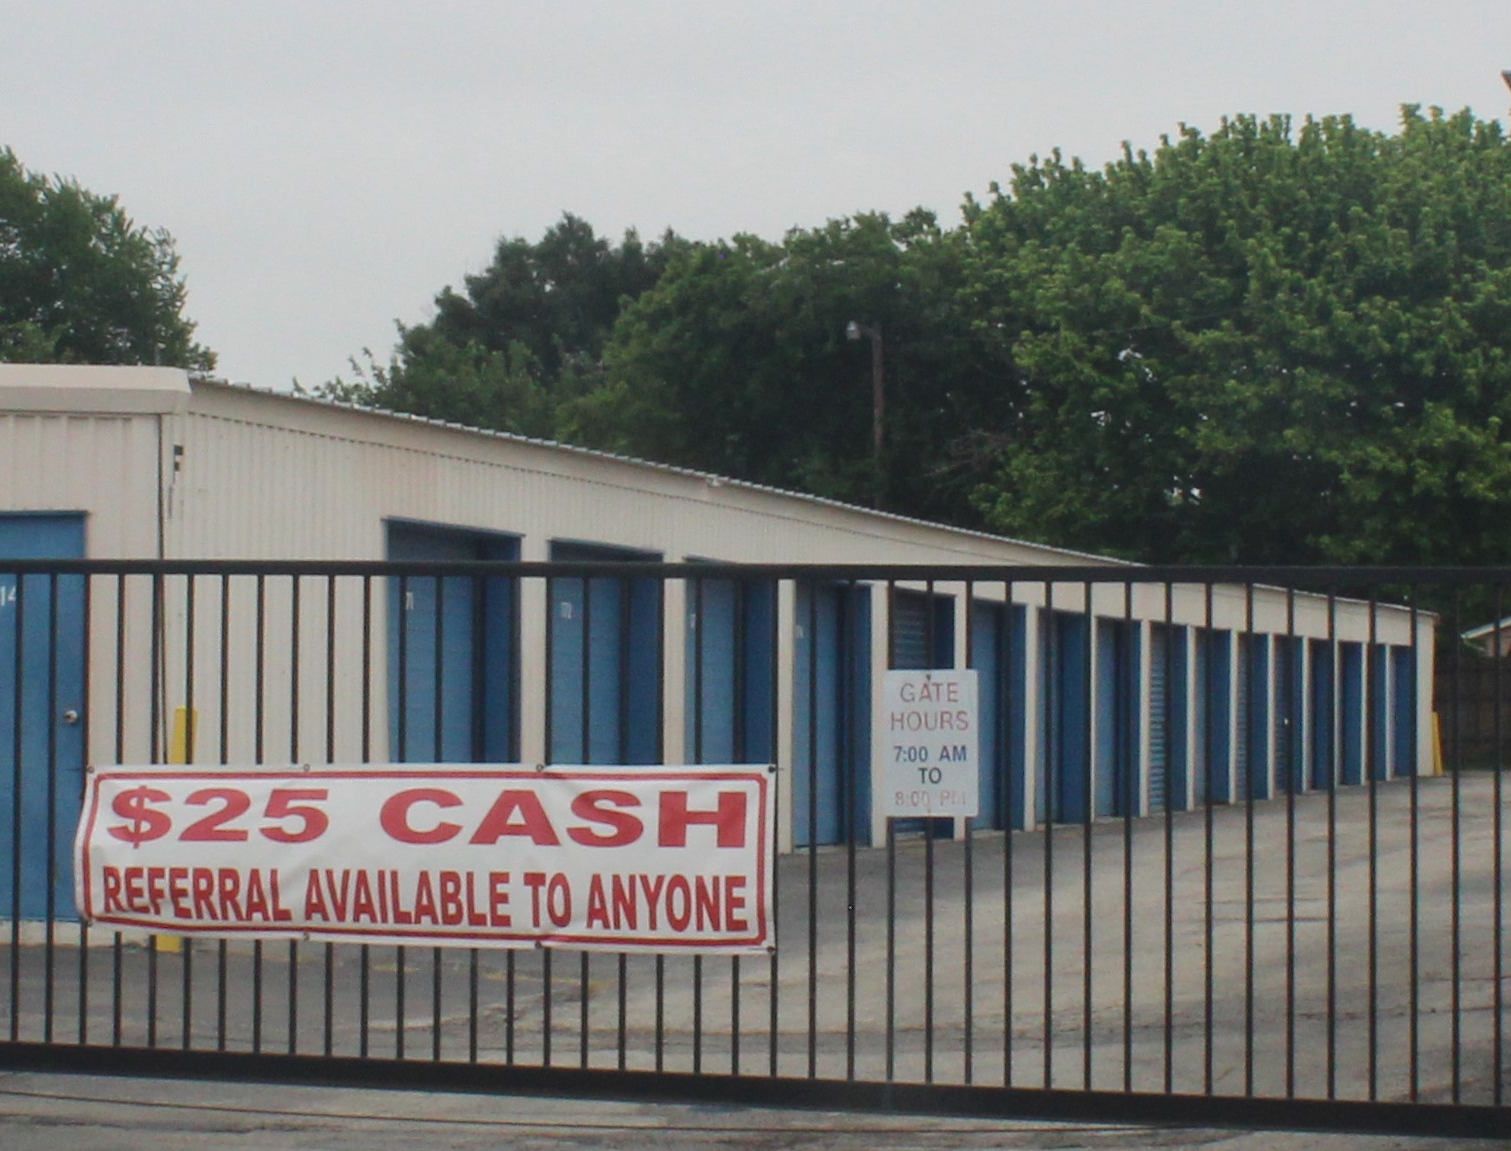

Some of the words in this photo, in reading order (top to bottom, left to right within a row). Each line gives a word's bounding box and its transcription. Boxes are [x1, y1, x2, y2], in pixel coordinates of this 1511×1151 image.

[900, 682, 958, 703] GATE
[890, 710, 969, 731] HOURS
[893, 746, 928, 763] 7:00
[939, 745, 967, 762] AM
[918, 767, 943, 784] TO
[106, 785, 329, 849] $25
[380, 788, 747, 848] CASH
[103, 866, 292, 921] REFERRAL
[305, 868, 512, 928] AVAILABLE
[523, 872, 572, 928] TO
[586, 873, 748, 932] ANYONE
